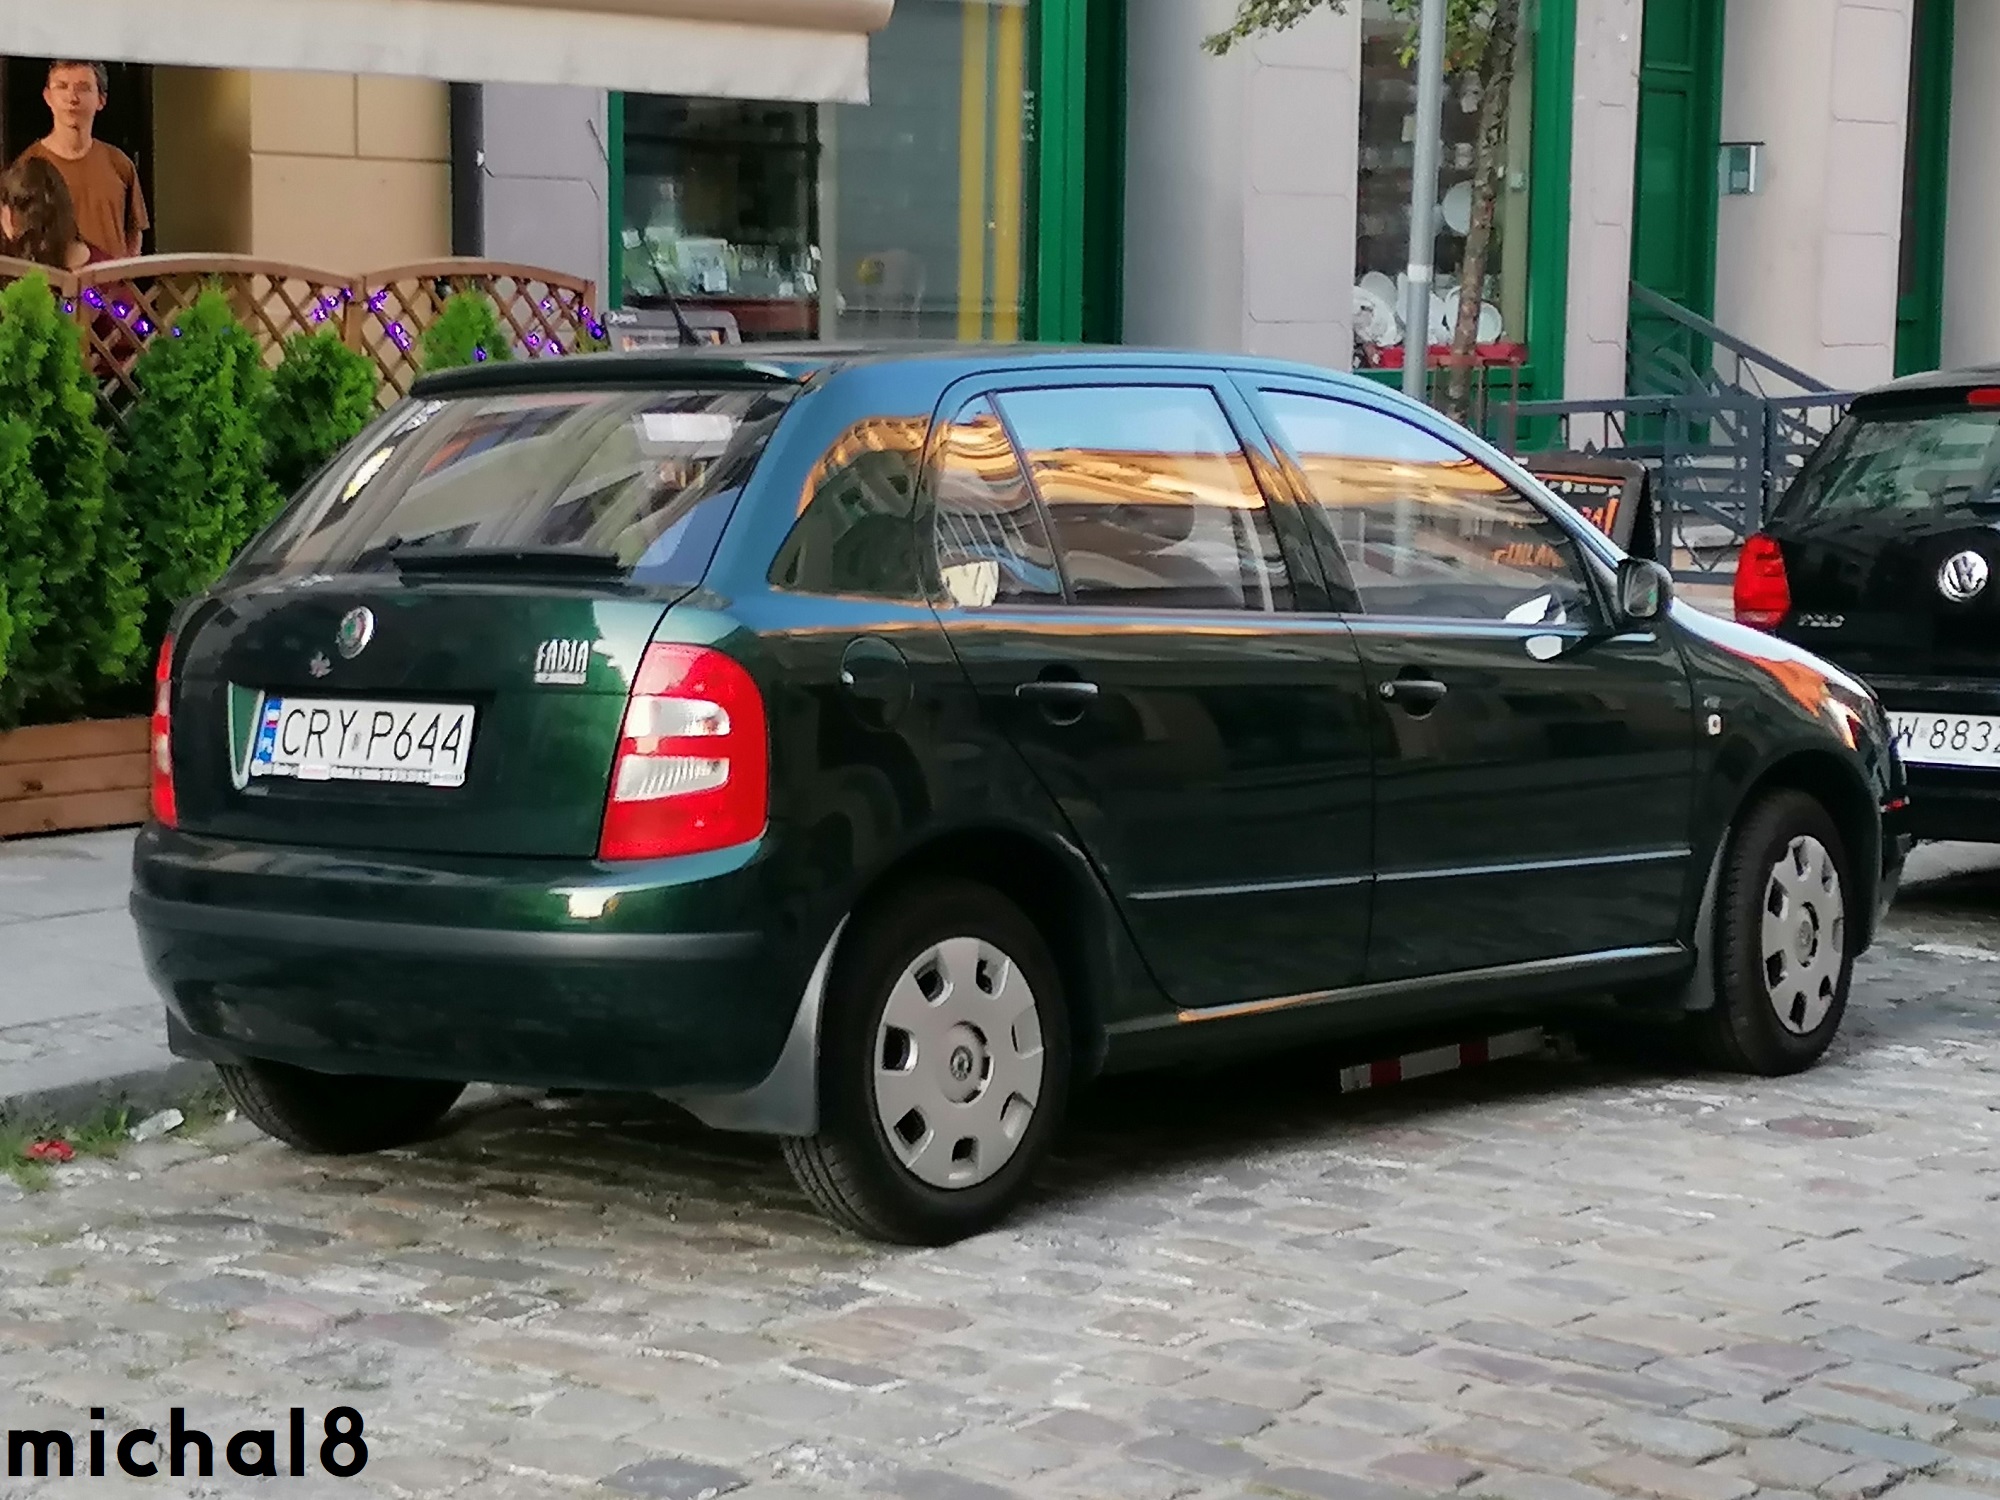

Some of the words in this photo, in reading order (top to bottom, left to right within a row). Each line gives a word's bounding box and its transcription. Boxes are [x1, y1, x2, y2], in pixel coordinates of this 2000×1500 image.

[534, 639, 589, 673] FABIA
[281, 708, 358, 759] CRY
[366, 711, 465, 764] P644
